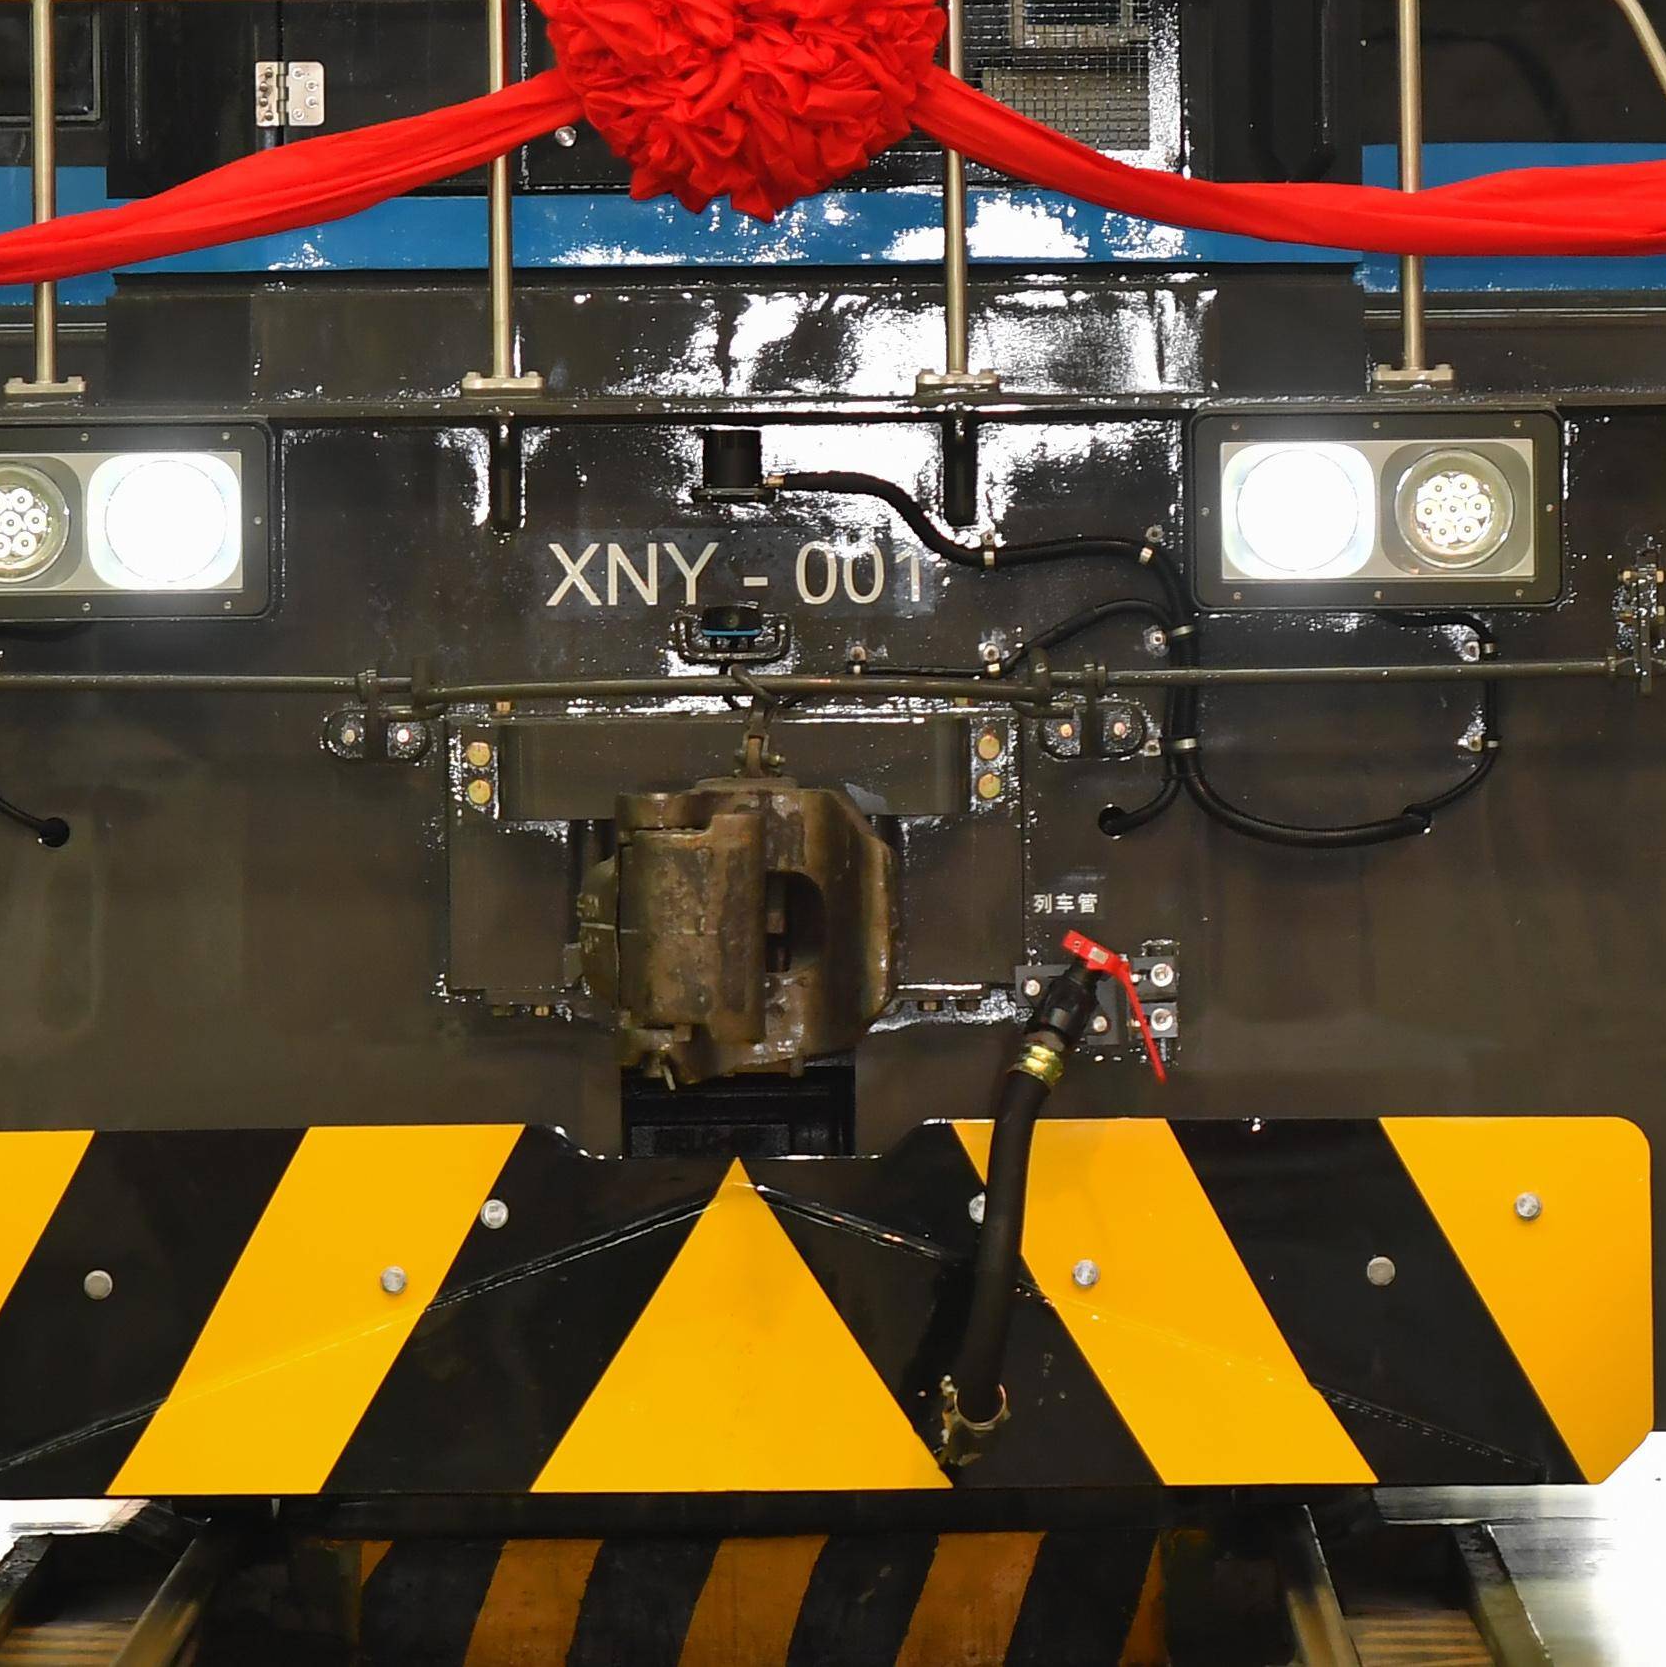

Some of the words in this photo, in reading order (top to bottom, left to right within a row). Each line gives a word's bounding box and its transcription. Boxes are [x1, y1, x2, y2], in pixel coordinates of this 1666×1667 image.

[545, 541, 720, 607] XNY
[795, 541, 923, 605] 001
[1032, 893, 1099, 914] 列车管
